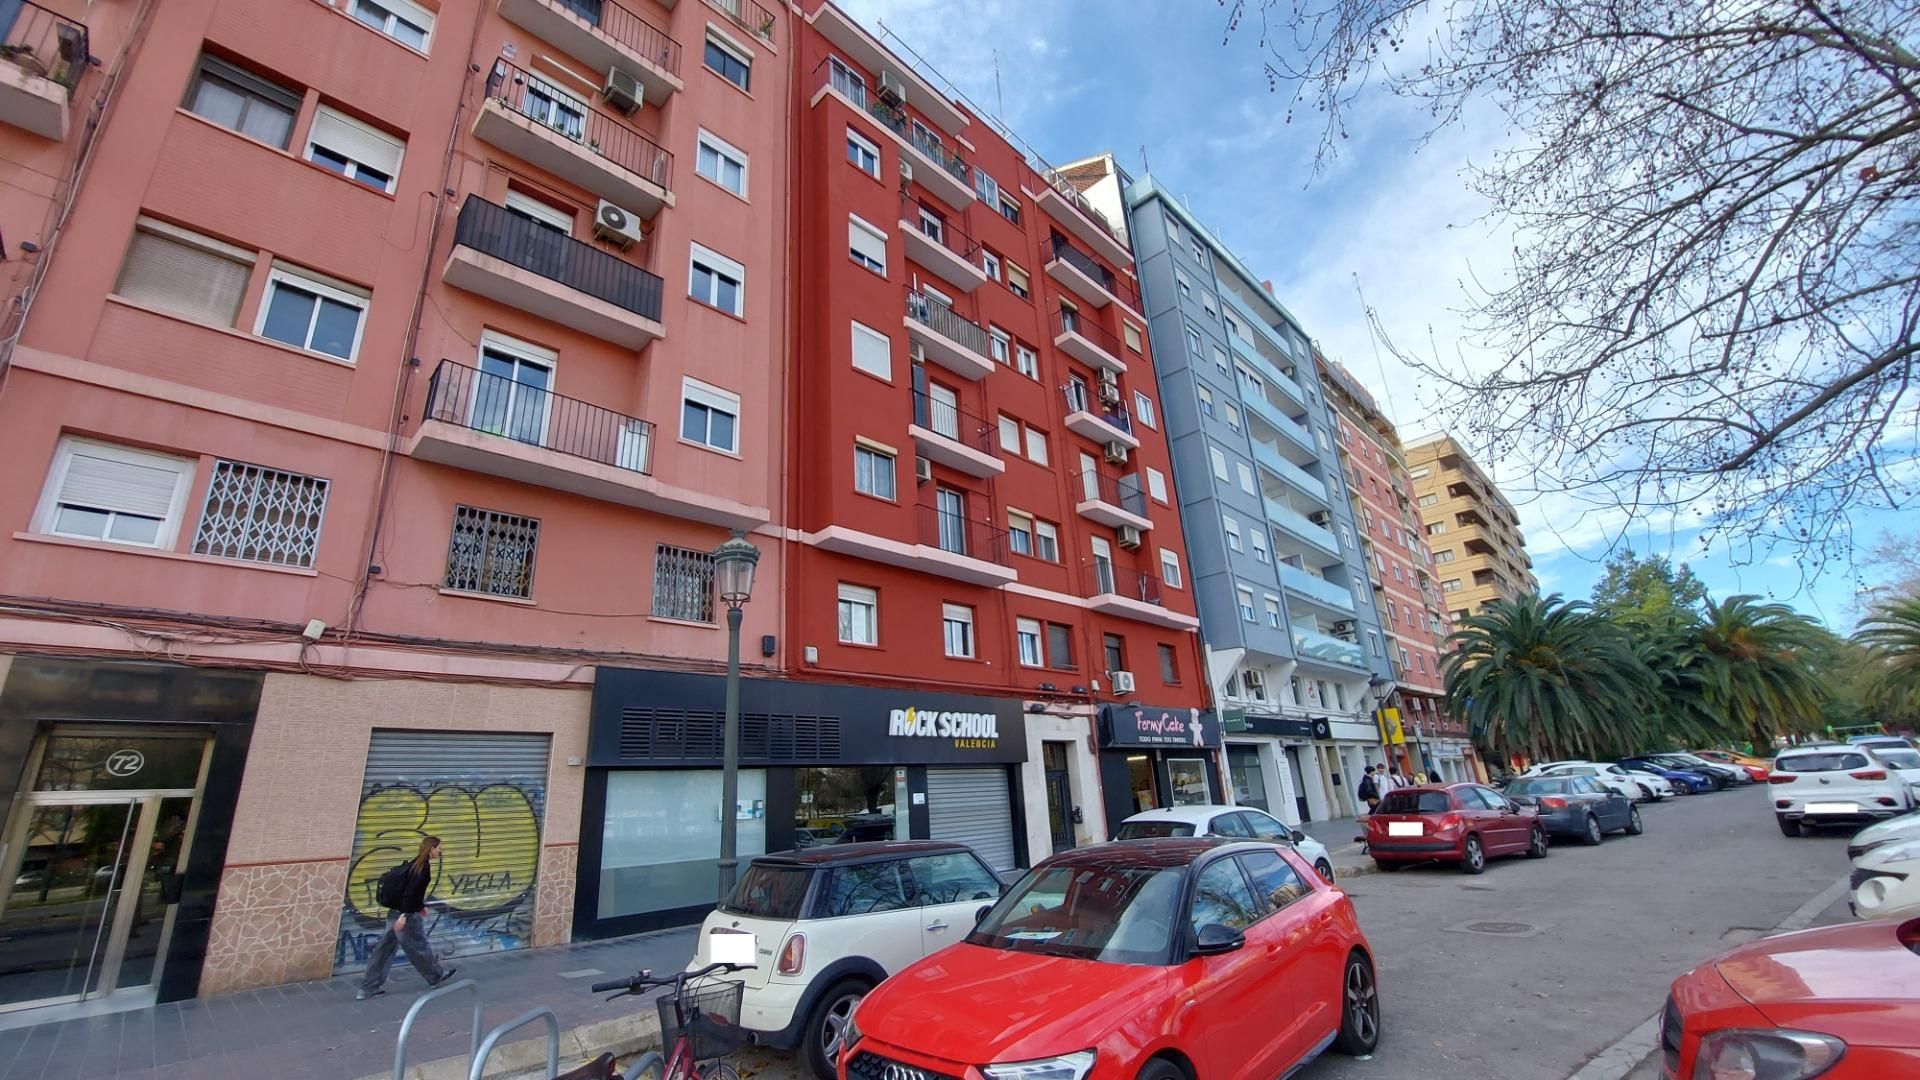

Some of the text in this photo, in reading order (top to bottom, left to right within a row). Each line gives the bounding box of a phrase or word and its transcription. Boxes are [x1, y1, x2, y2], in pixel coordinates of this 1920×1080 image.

[889, 706, 999, 738] ROCK SCHOOL
[954, 739, 996, 749] VALENCIA
[113, 754, 140, 770] 72
